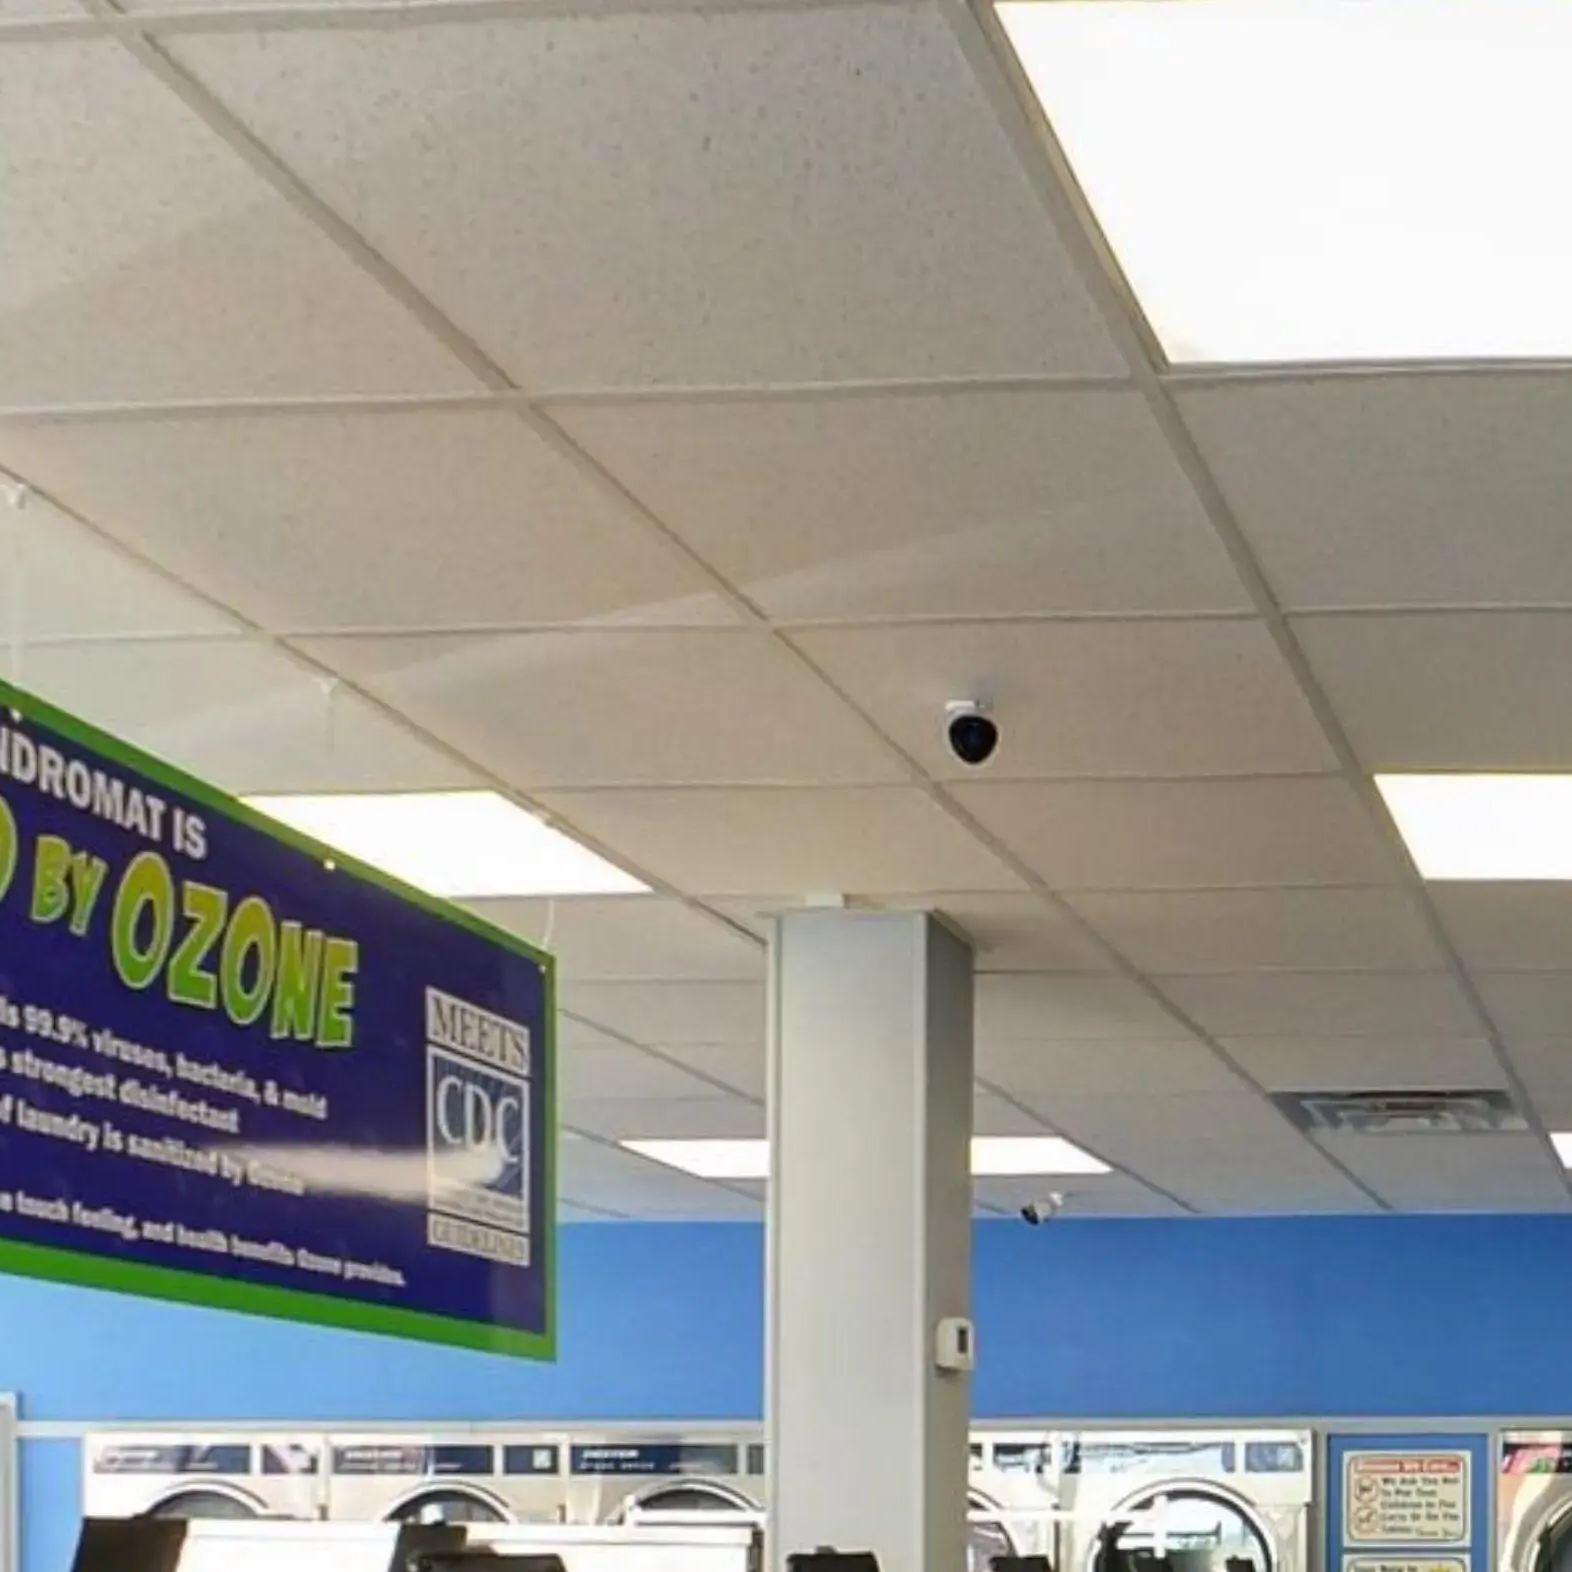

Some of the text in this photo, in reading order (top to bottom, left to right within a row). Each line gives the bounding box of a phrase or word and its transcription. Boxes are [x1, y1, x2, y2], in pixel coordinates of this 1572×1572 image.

[172, 807, 208, 860] IS
[29, 834, 108, 936] BY
[111, 850, 359, 1048] OZONE
[24, 1005, 88, 1049] 99.9%
[432, 997, 527, 1067] MEETS
[11, 1047, 118, 1101] strongest
[16, 1100, 102, 1152] laundry
[103, 1121, 124, 1152] is
[436, 1073, 520, 1166] CDC
